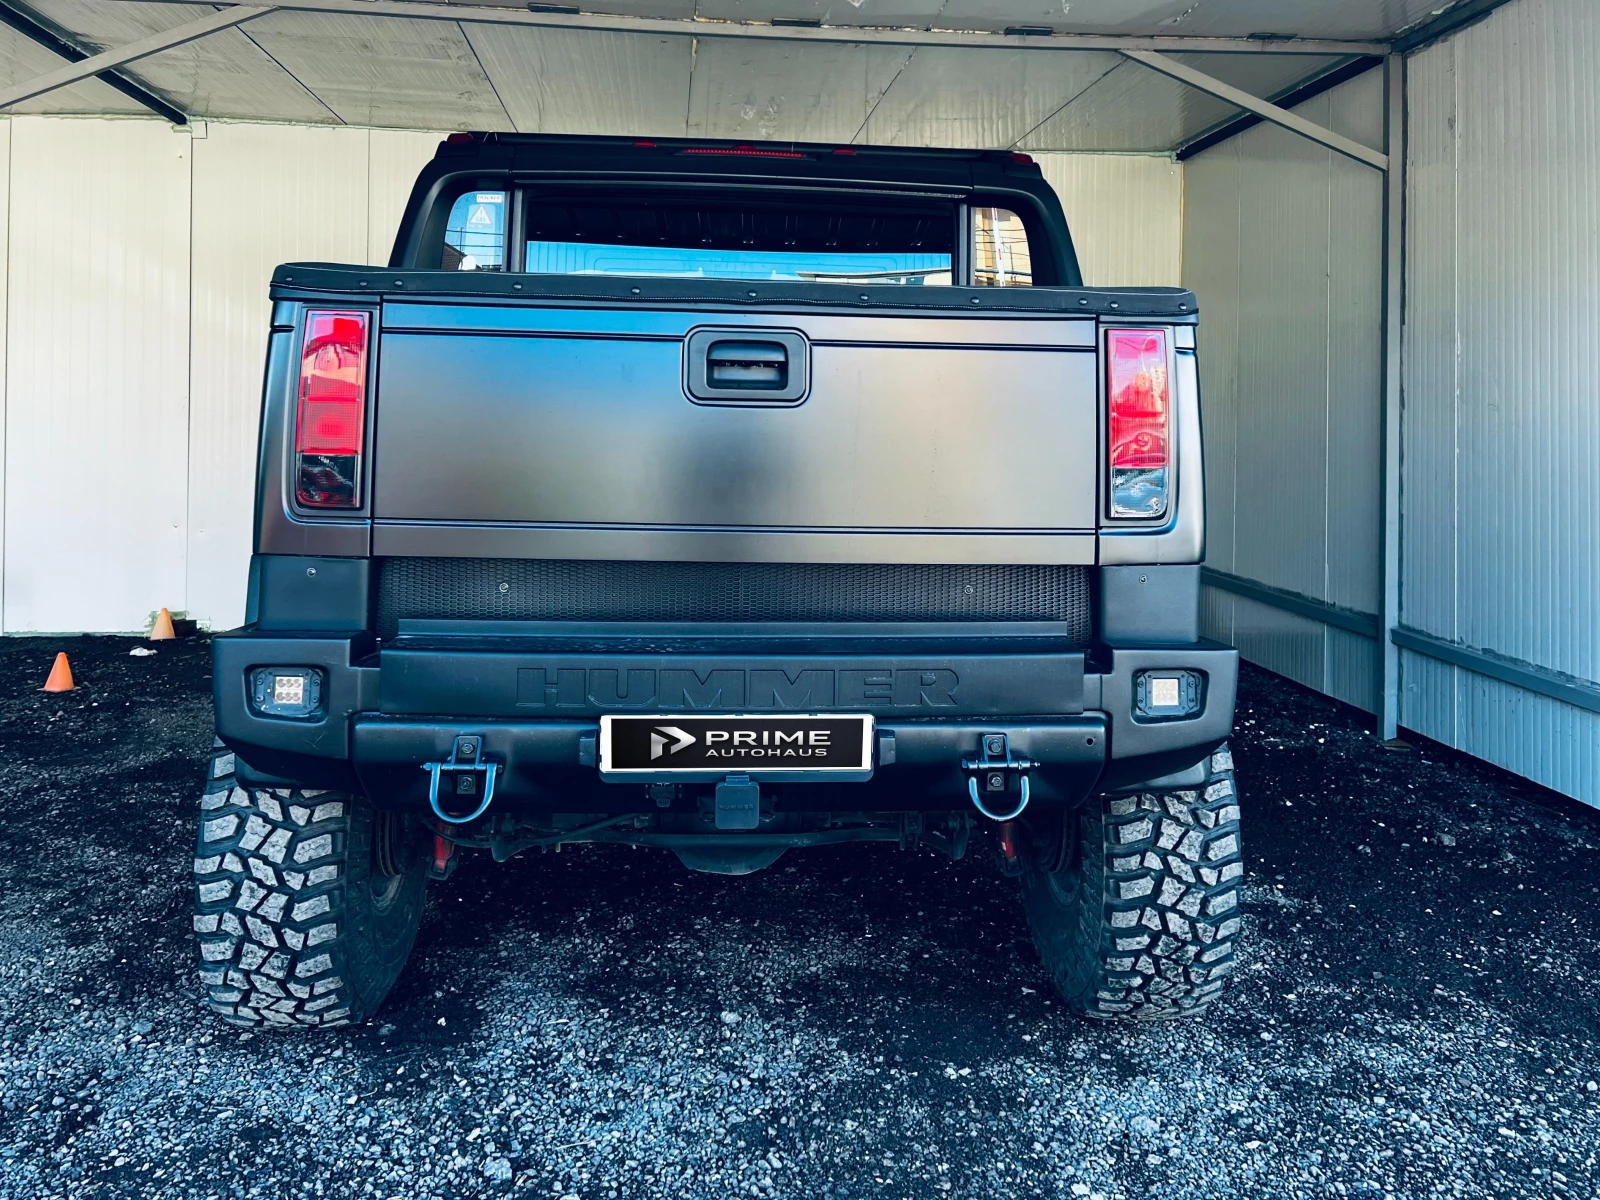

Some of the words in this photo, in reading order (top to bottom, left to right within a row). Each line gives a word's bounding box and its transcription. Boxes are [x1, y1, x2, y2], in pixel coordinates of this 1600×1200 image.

[516, 667, 960, 708] HUMMER
[705, 730, 831, 746] PRIME
[705, 748, 828, 757] AUTOHAUS
